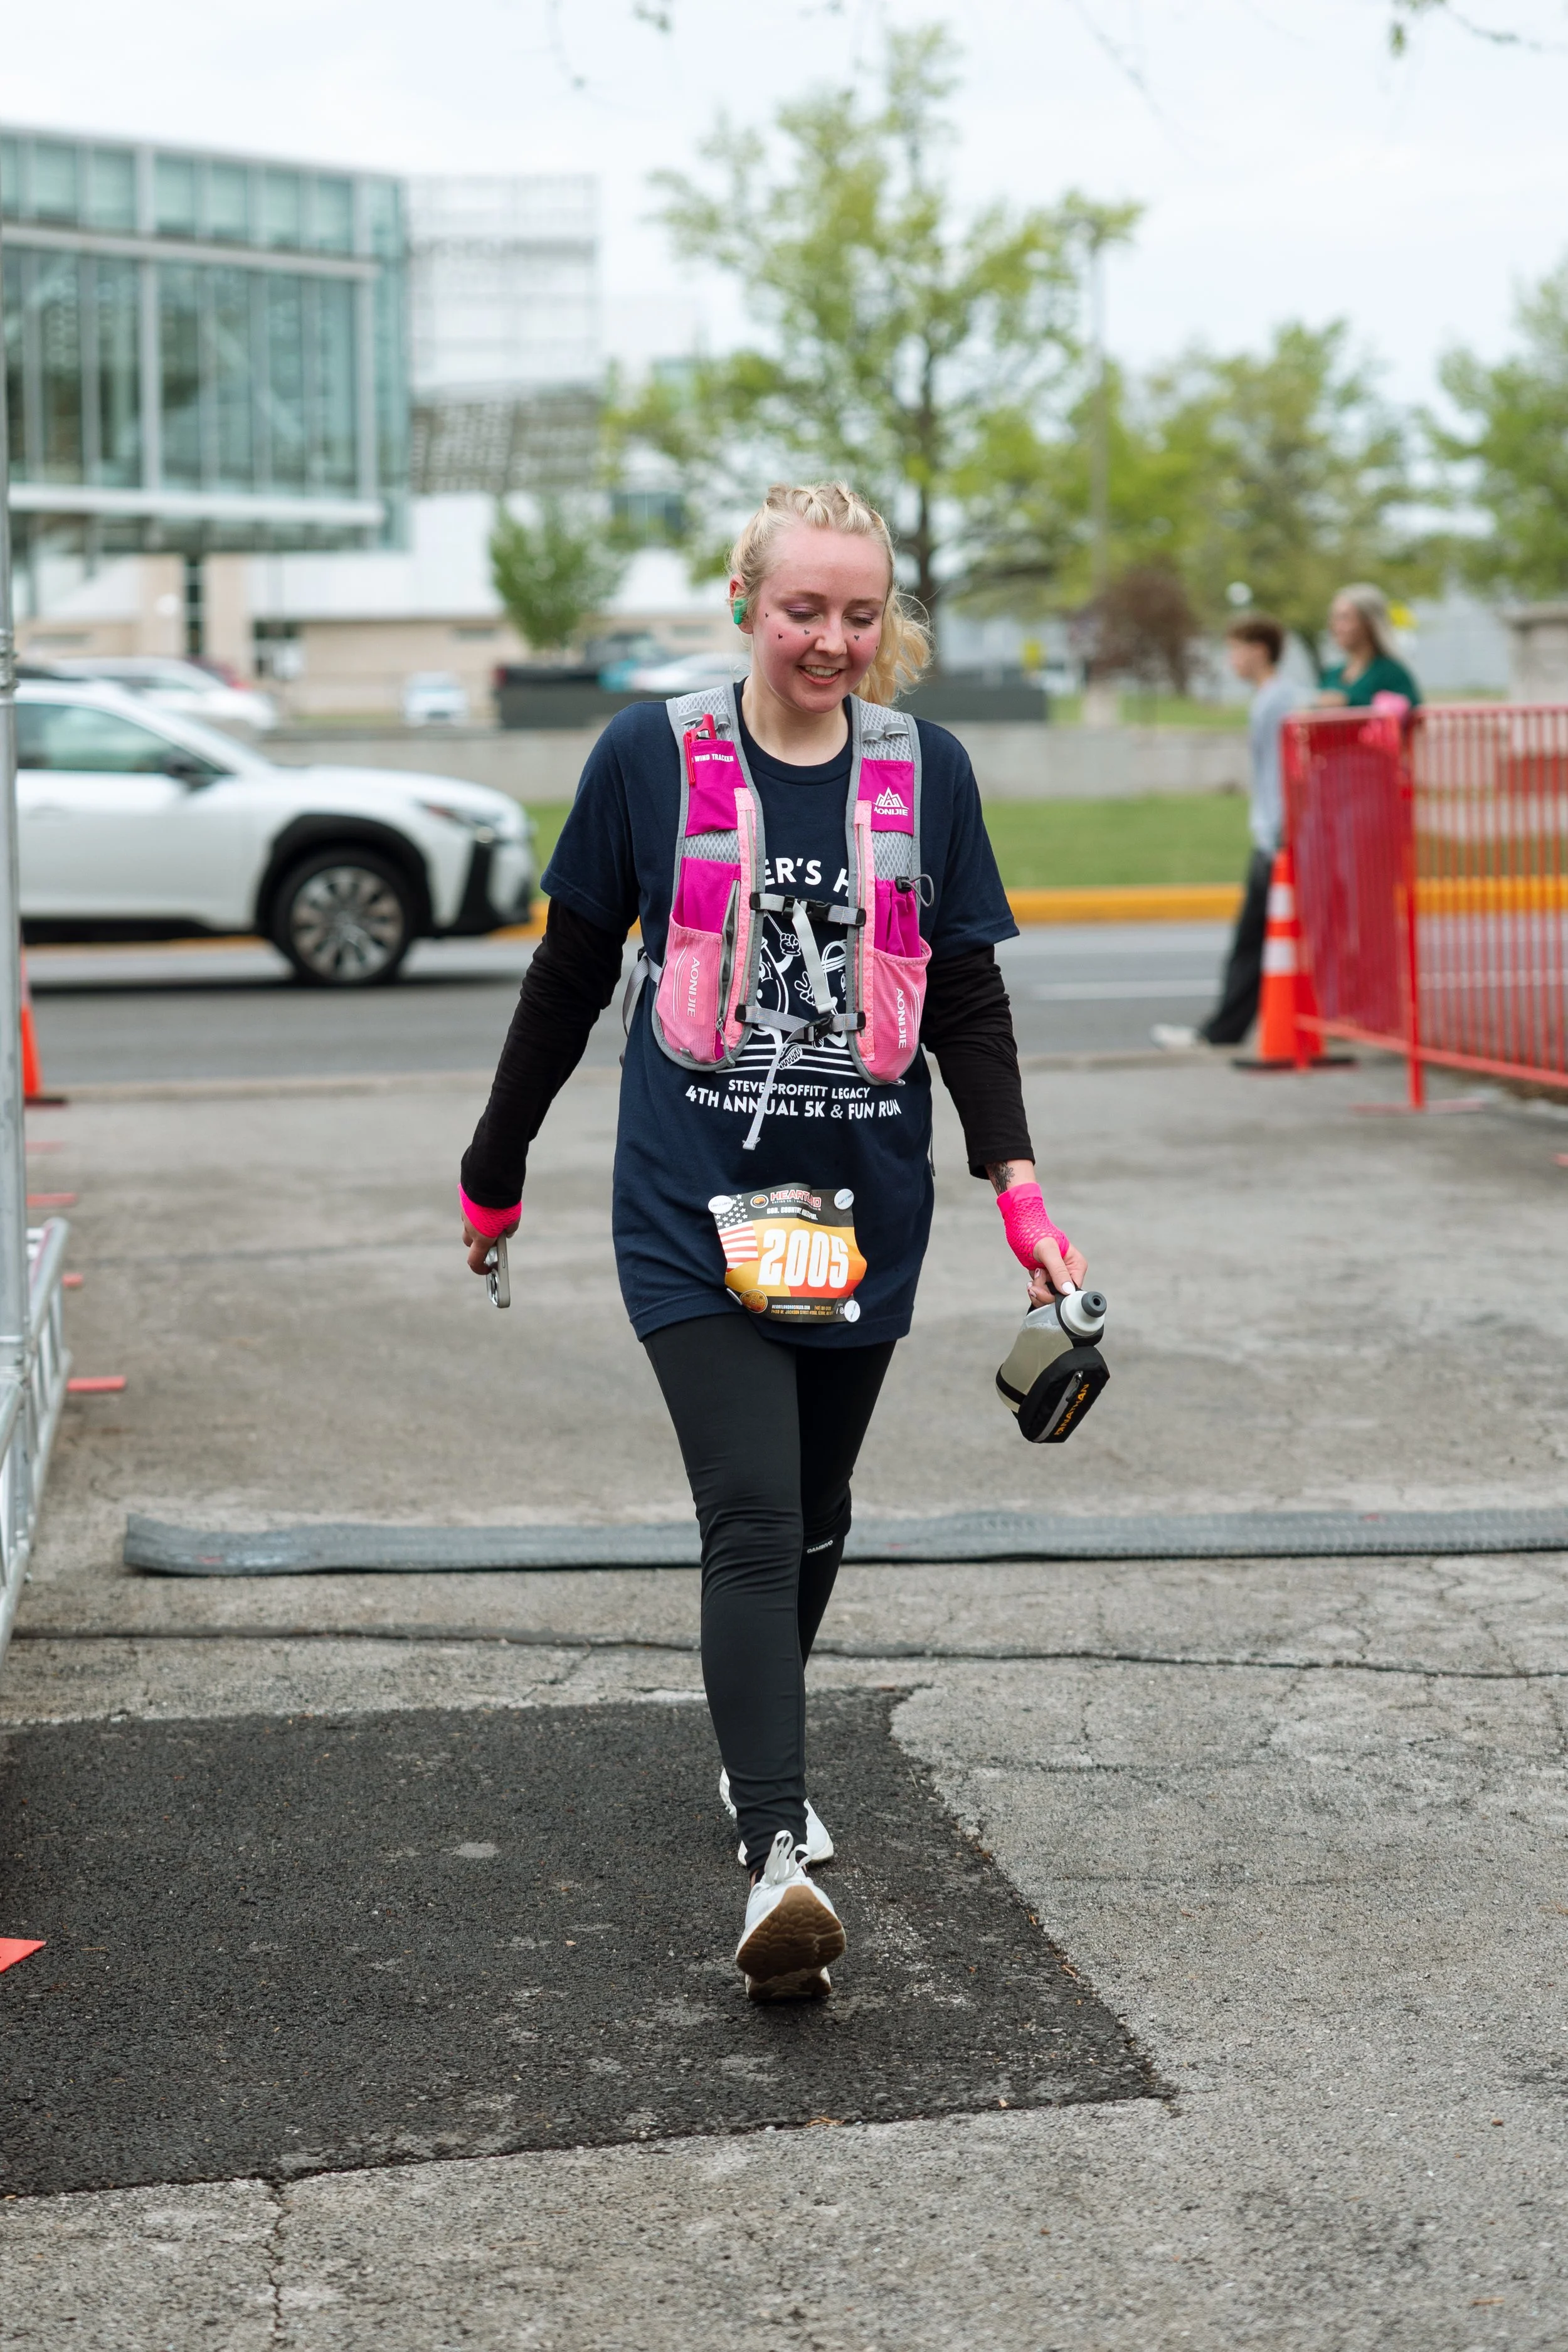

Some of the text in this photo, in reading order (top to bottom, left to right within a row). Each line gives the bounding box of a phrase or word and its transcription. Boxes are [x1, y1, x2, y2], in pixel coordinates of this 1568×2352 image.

[694, 754, 710, 762] WIND
[711, 753, 734, 762] TRACKER
[874, 806, 908, 817] AONIJIE
[765, 857, 822, 886] ER'S
[687, 956, 701, 1017] AONIJIE
[896, 987, 907, 1049] AONIJIE
[686, 1085, 902, 1120] 4TH ANNUAL 5K & FUN RUN
[728, 1079, 870, 1099] STEVE PROFFITT LEGACY
[757, 1228, 849, 1289] 2005
